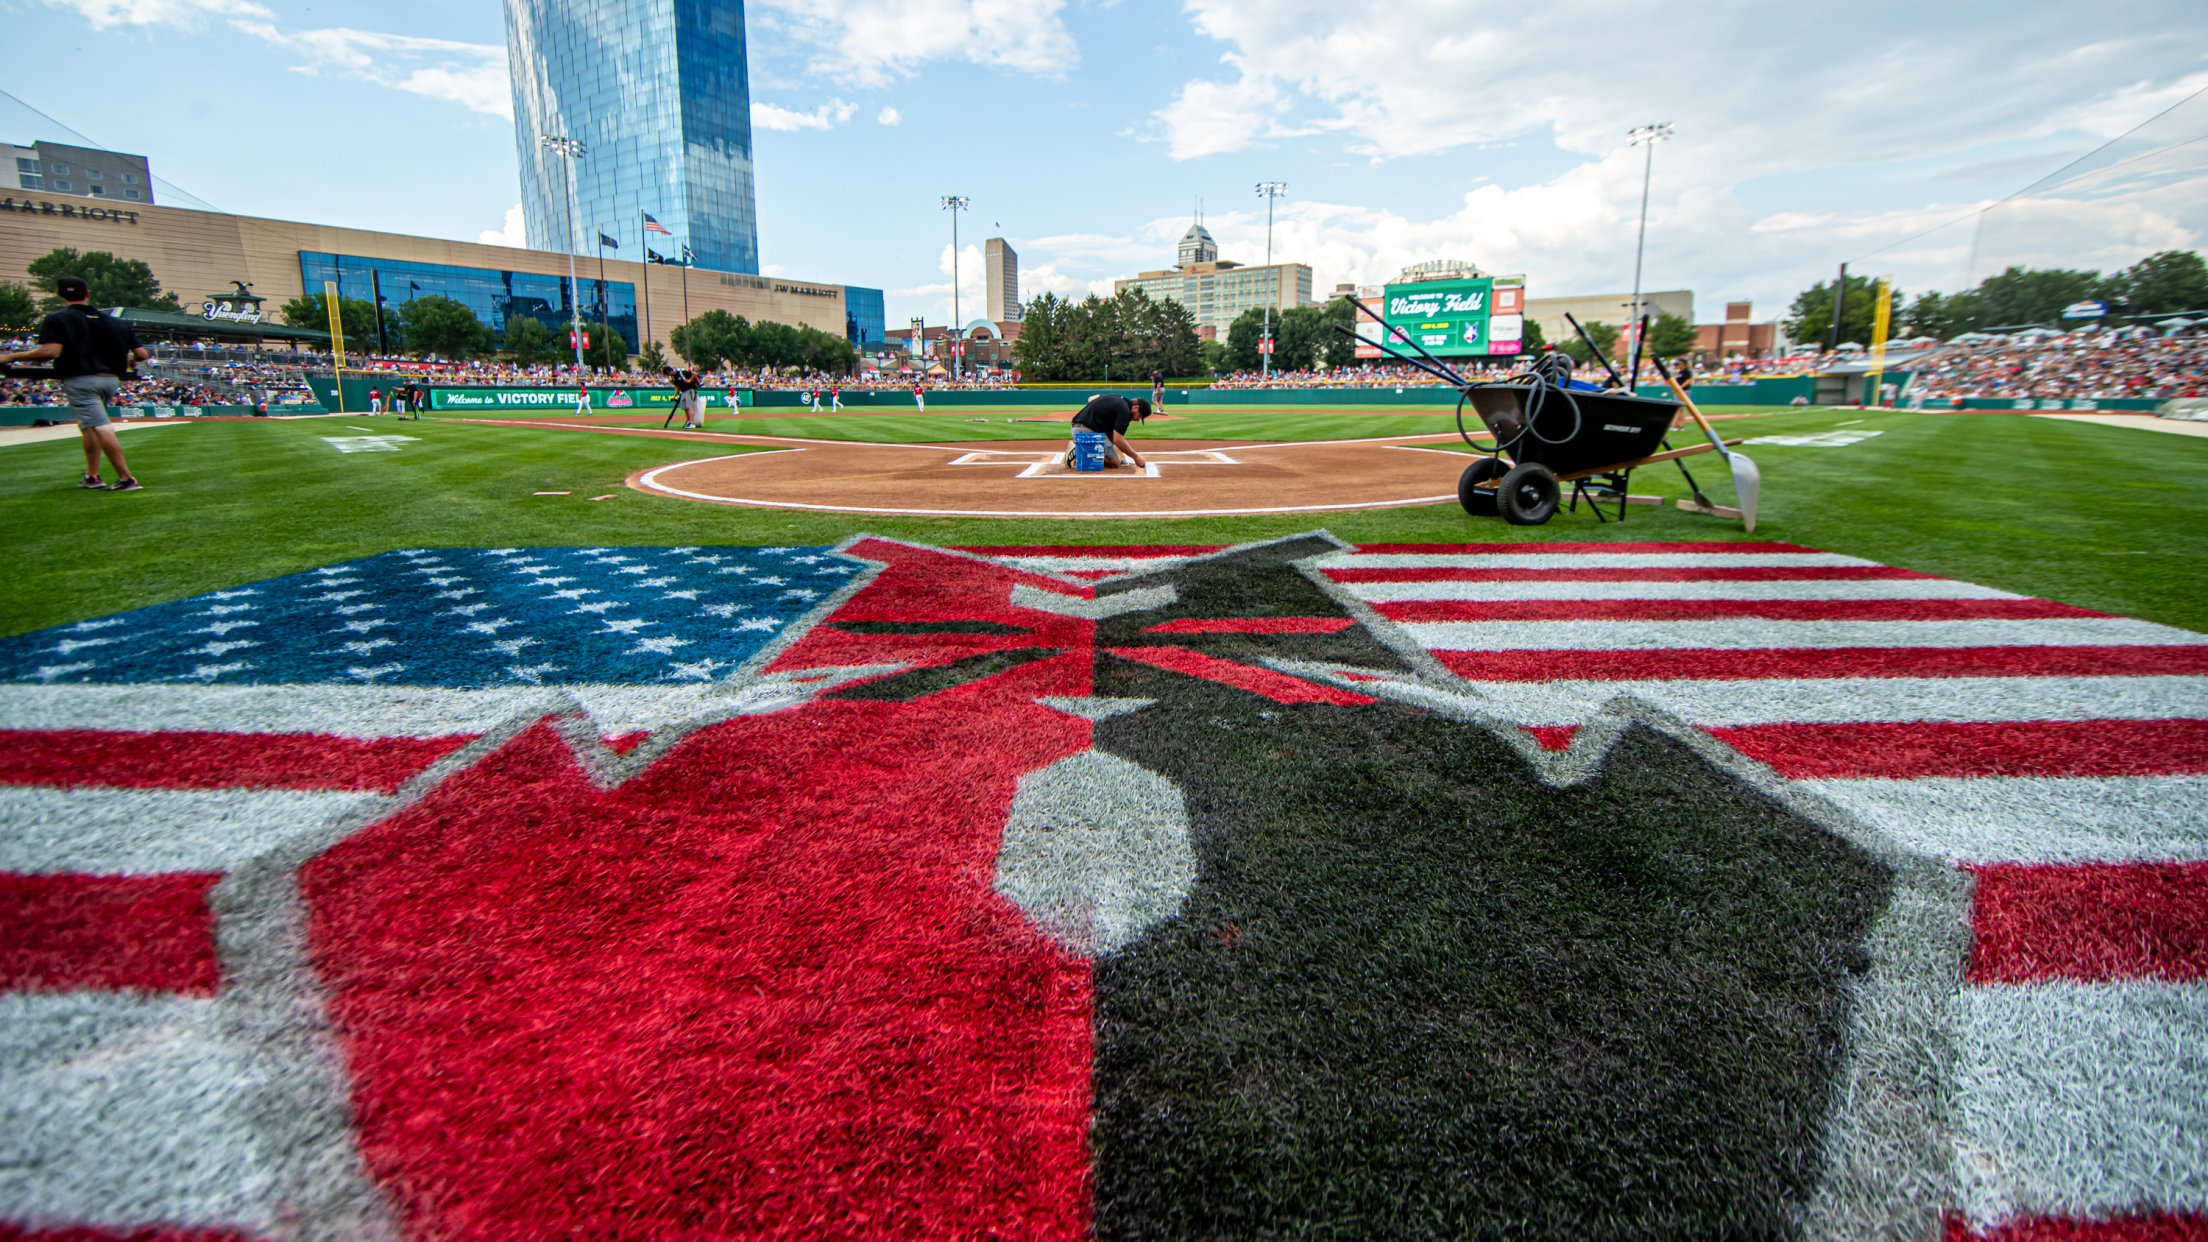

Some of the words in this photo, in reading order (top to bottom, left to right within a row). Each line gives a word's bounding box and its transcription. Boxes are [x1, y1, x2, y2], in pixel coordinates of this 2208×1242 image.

[790, 286, 838, 299] MARRIOTT
[202, 301, 262, 326] Yuengling
[1391, 297, 1440, 318] Victory
[1442, 292, 1484, 312] Field
[446, 393, 483, 404] Welcome
[484, 395, 494, 404] to
[497, 393, 555, 404] VICTORY
